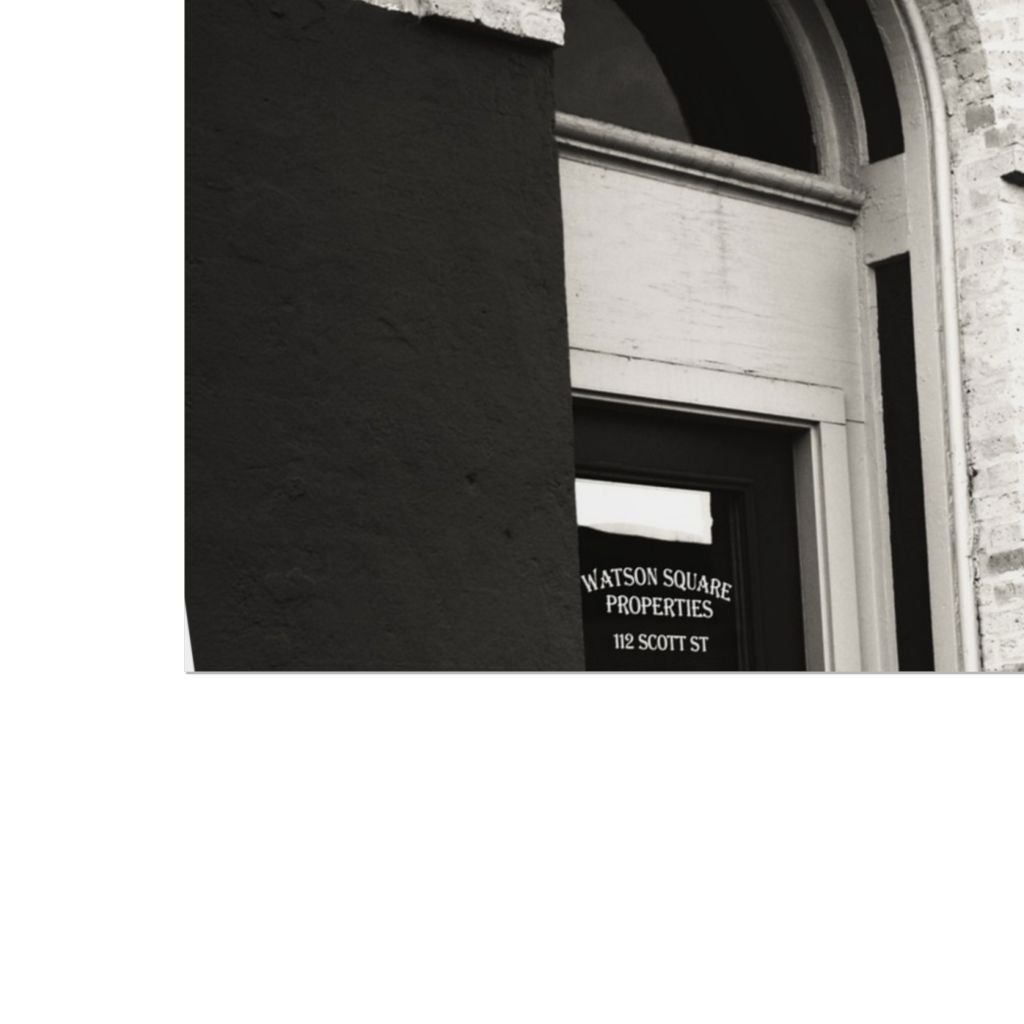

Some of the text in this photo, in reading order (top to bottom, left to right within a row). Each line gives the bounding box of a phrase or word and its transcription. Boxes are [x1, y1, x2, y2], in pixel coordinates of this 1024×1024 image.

[580, 566, 733, 602] WATSON SQUARE
[606, 594, 714, 619] PROPERTIES
[613, 632, 710, 653] 112 SCOTT ST
